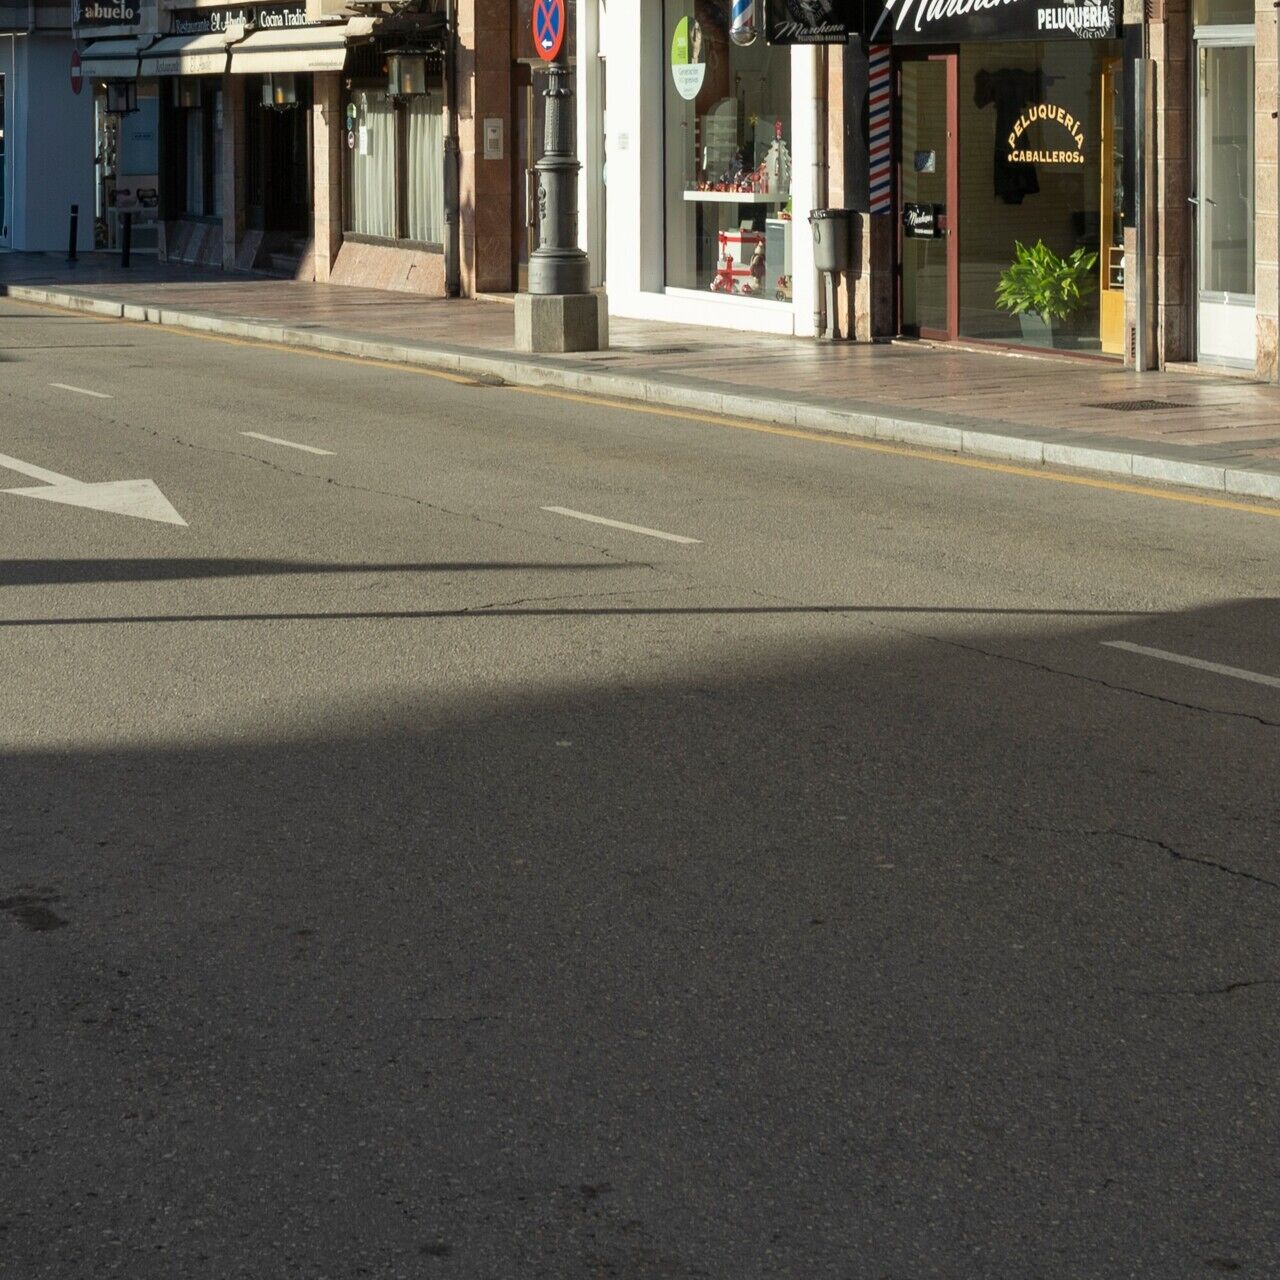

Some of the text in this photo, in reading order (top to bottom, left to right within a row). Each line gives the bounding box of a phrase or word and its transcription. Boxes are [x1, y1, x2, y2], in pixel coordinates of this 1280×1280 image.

[85, 3, 134, 19] abuelo
[261, 10, 283, 27] Cocina
[1037, 2, 1111, 33] PELUQUERÍA
[1008, 104, 1084, 150] PELUQUERÍA
[1012, 150, 1080, 163] CABALLEROS
